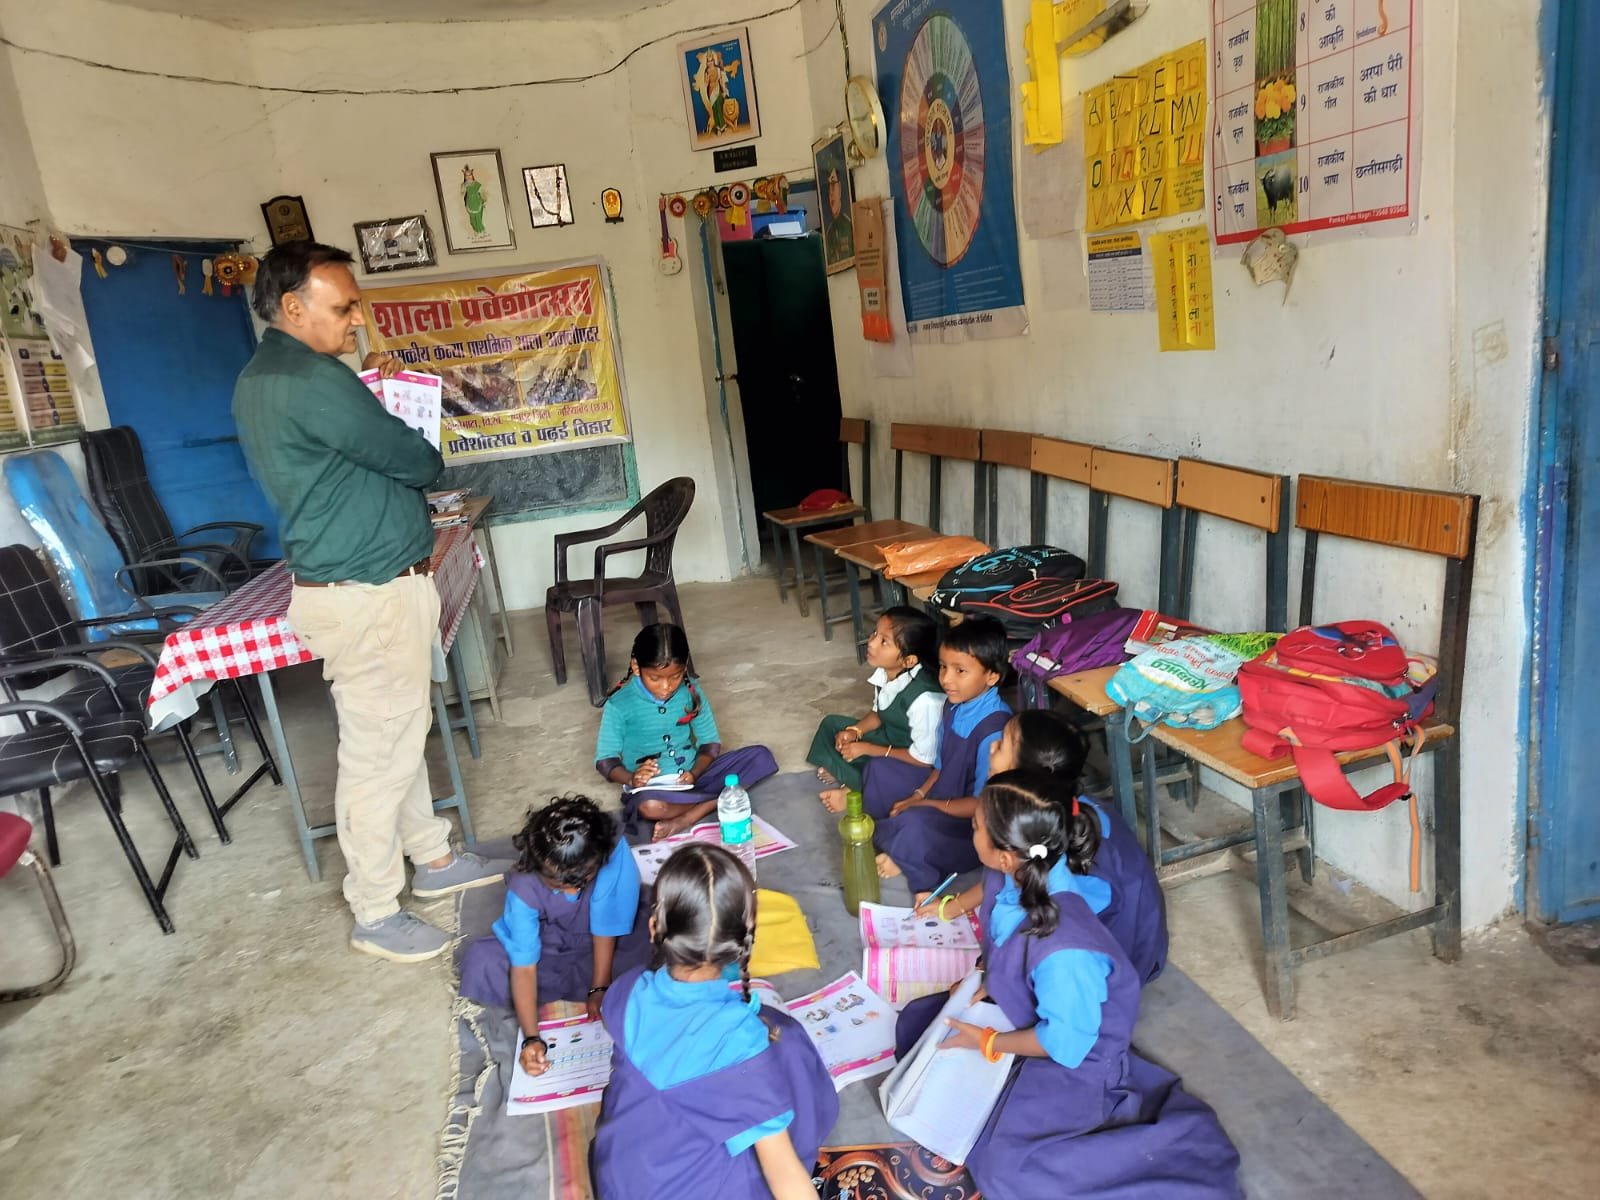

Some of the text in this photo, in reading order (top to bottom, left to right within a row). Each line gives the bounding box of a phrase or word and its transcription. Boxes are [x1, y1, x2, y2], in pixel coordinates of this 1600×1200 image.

[1299, 12, 1306, 31] 8
[1318, 25, 1344, 49] आकृति
[1360, 53, 1403, 82] अरपा पैरी
[1088, 98, 1102, 126] A
[1109, 89, 1117, 120] B
[1154, 67, 1165, 104] E
[1317, 75, 1344, 94] राजकीय
[1363, 83, 1397, 104] की धार
[1149, 106, 1161, 135] L
[1170, 95, 1184, 135] M
[1181, 91, 1201, 132] N
[1300, 94, 1306, 112] 9
[1324, 95, 1338, 110] गीत
[1092, 159, 1102, 188] O
[1110, 152, 1117, 183] P
[1173, 136, 1184, 167] T
[1317, 149, 1345, 167] राजकीय
[1298, 175, 1309, 194] 10
[1323, 173, 1339, 186] भाषा
[1120, 183, 1136, 216] X
[1141, 179, 1149, 215] Y
[1149, 177, 1162, 212] Z
[1217, 195, 1222, 211] 5
[371, 299, 453, 338] शाला
[432, 342, 464, 360] कन्या
[466, 332, 512, 358] प्राथमिक
[515, 333, 543, 351] शाला
[448, 430, 517, 455] प्रवेशोत्सव
[520, 430, 532, 444] व
[573, 417, 613, 437] तिहार
[1150, 658, 1208, 690] KRIBHCO
